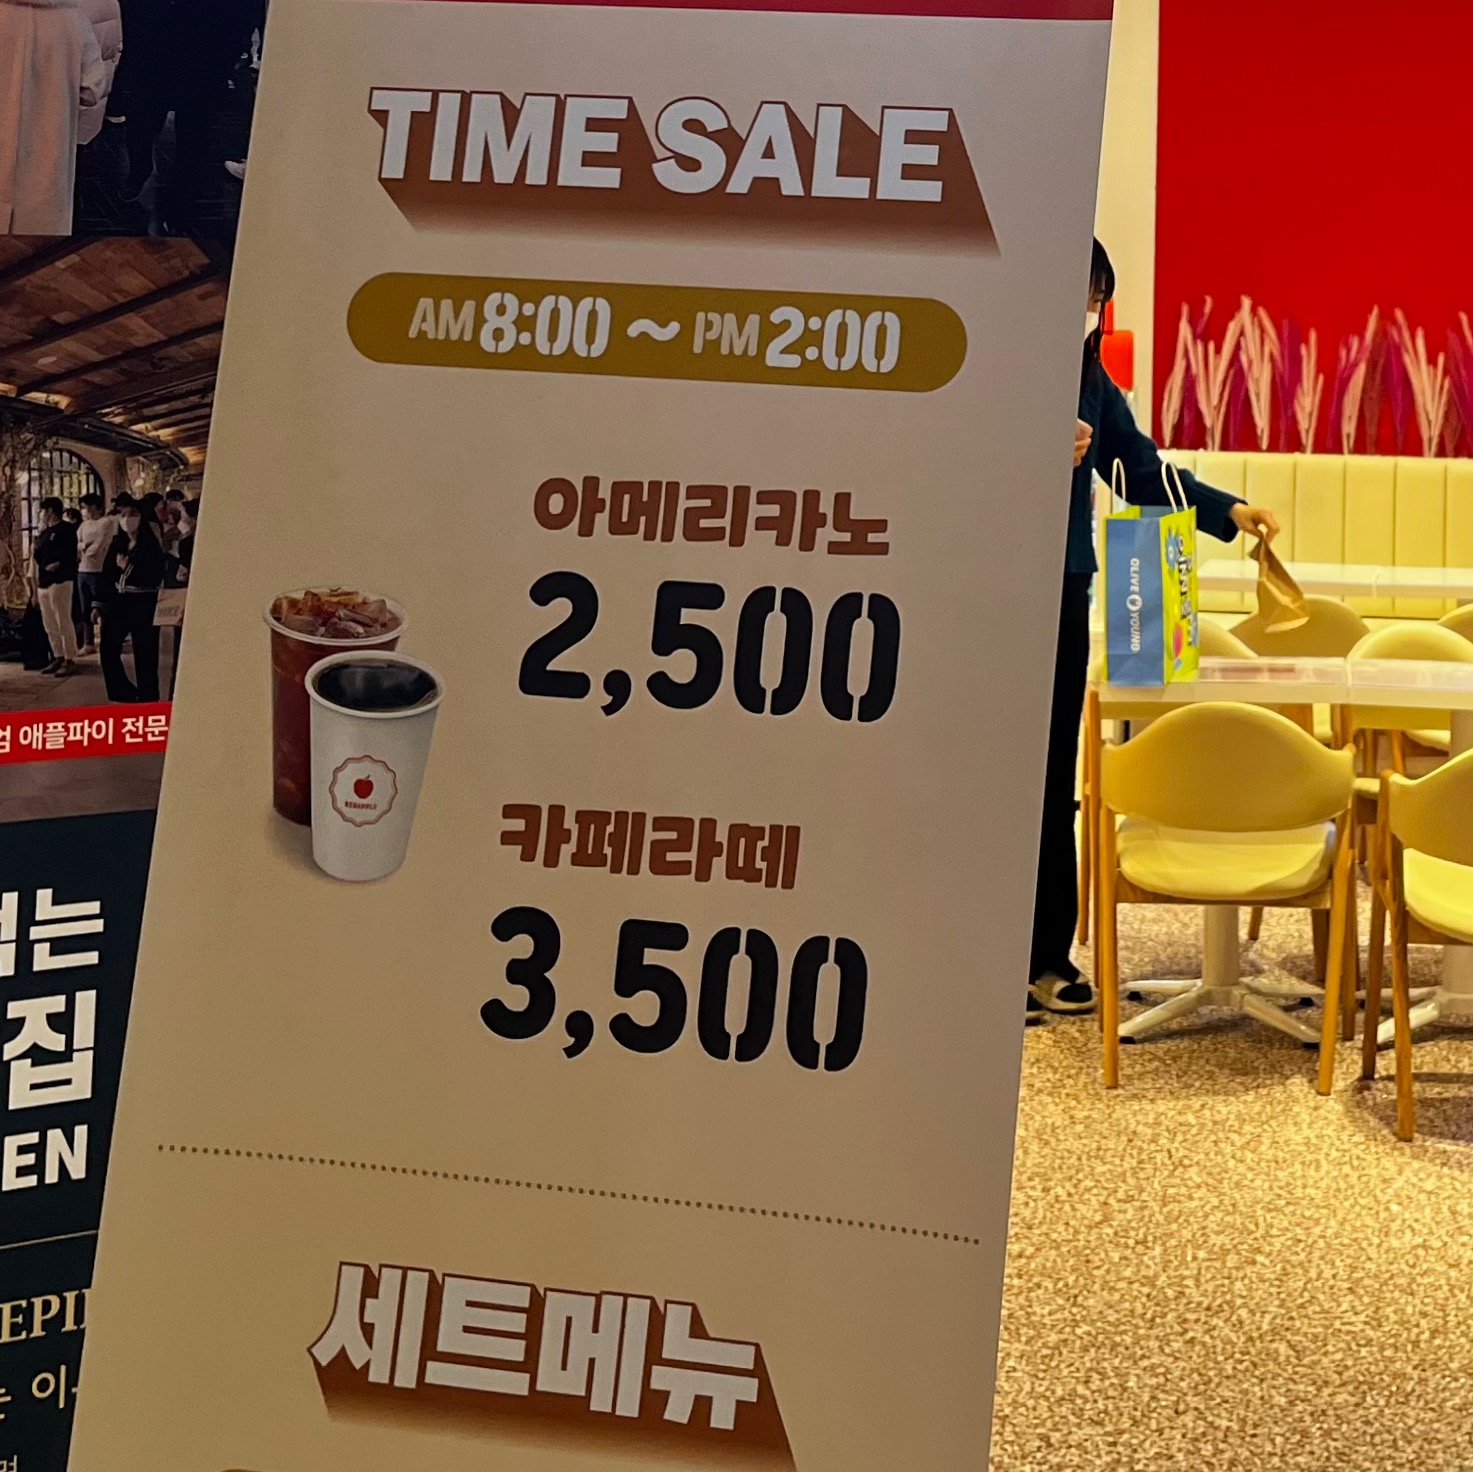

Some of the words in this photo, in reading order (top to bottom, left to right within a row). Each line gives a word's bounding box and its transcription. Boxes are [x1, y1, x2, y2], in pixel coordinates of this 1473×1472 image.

[370, 88, 633, 190] TIME
[652, 96, 952, 204] SALE
[533, 475, 890, 557] 아메리카노
[518, 570, 901, 723] 2,500
[18, 717, 114, 751] 애플파이
[121, 714, 169, 744] 전문
[499, 803, 801, 890] 카페라떼
[480, 905, 868, 1073] 3,500
[2, 988, 97, 1111] 집
[1, 1123, 89, 1192] EN
[31, 1364, 79, 1410] 이
[307, 1261, 762, 1432] 세트메뉴
